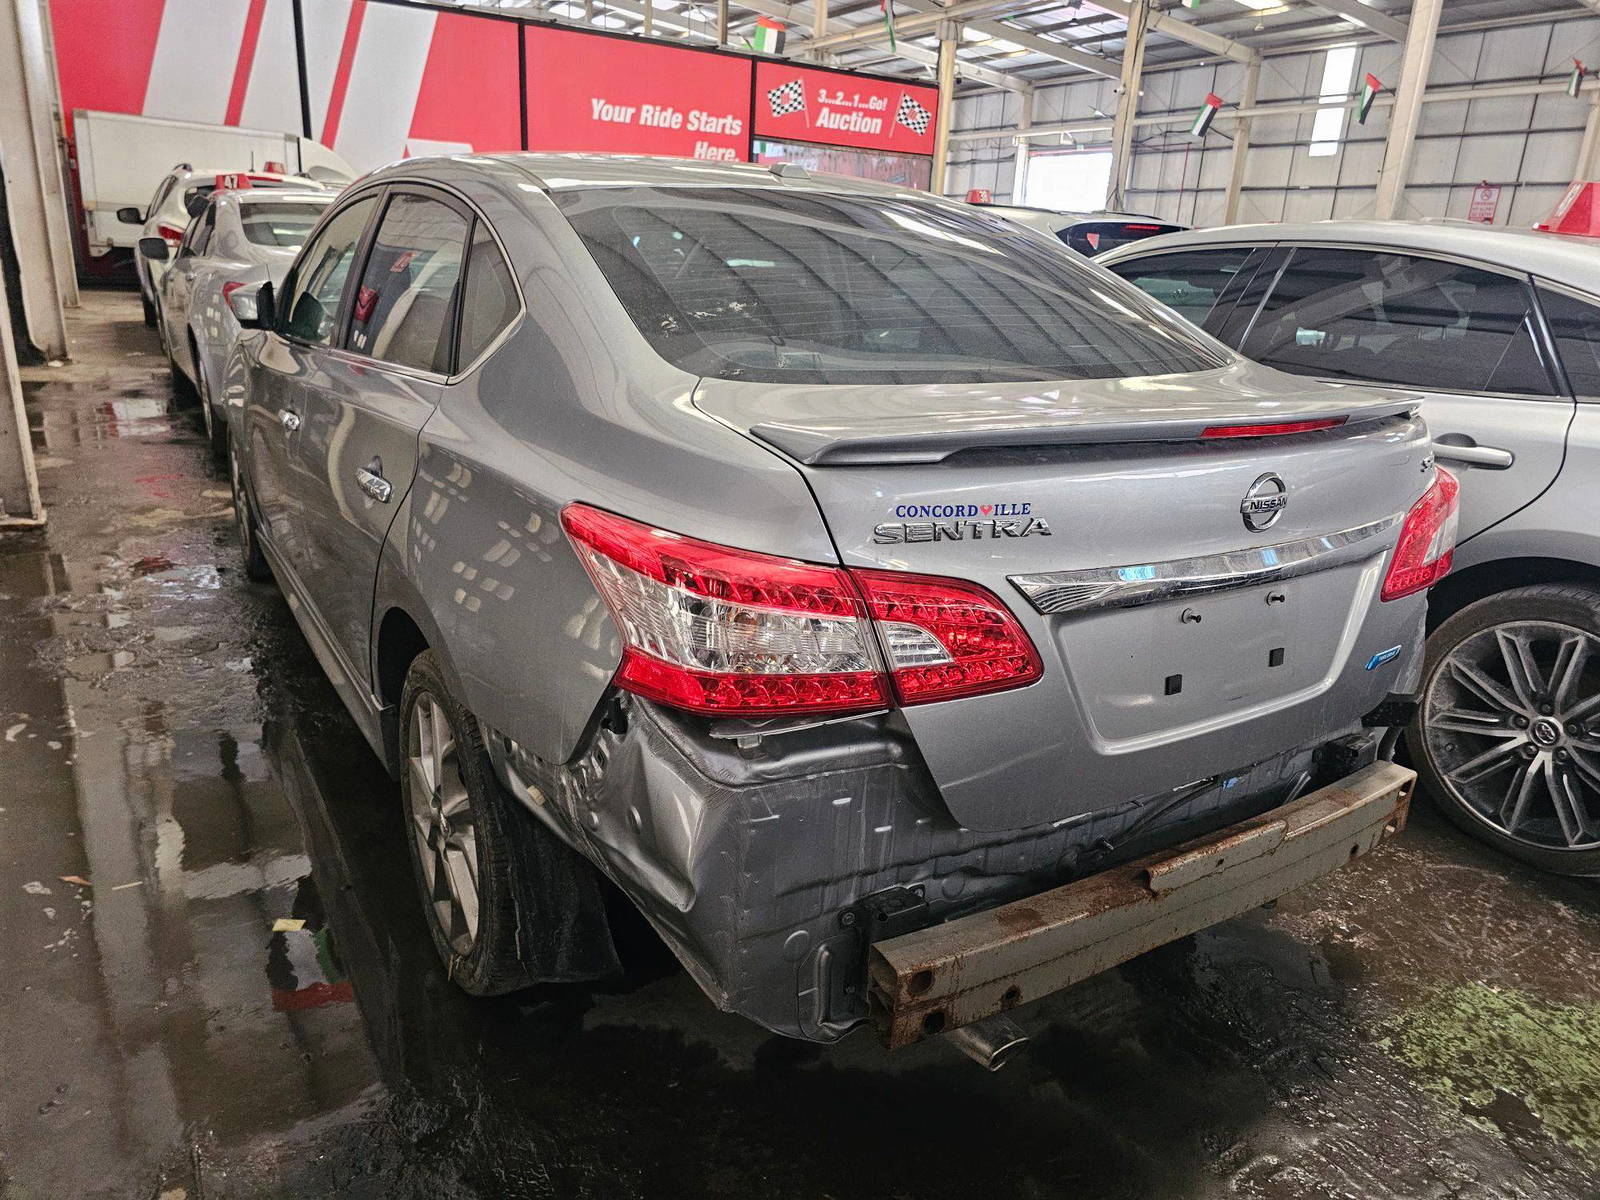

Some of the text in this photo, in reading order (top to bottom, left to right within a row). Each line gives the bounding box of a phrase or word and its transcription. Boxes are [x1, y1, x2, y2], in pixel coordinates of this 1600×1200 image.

[591, 98, 743, 136] Your Ride Starts
[815, 107, 883, 134] Auction
[1250, 496, 1288, 511] NISSAN
[873, 517, 1053, 545] SENTRA
